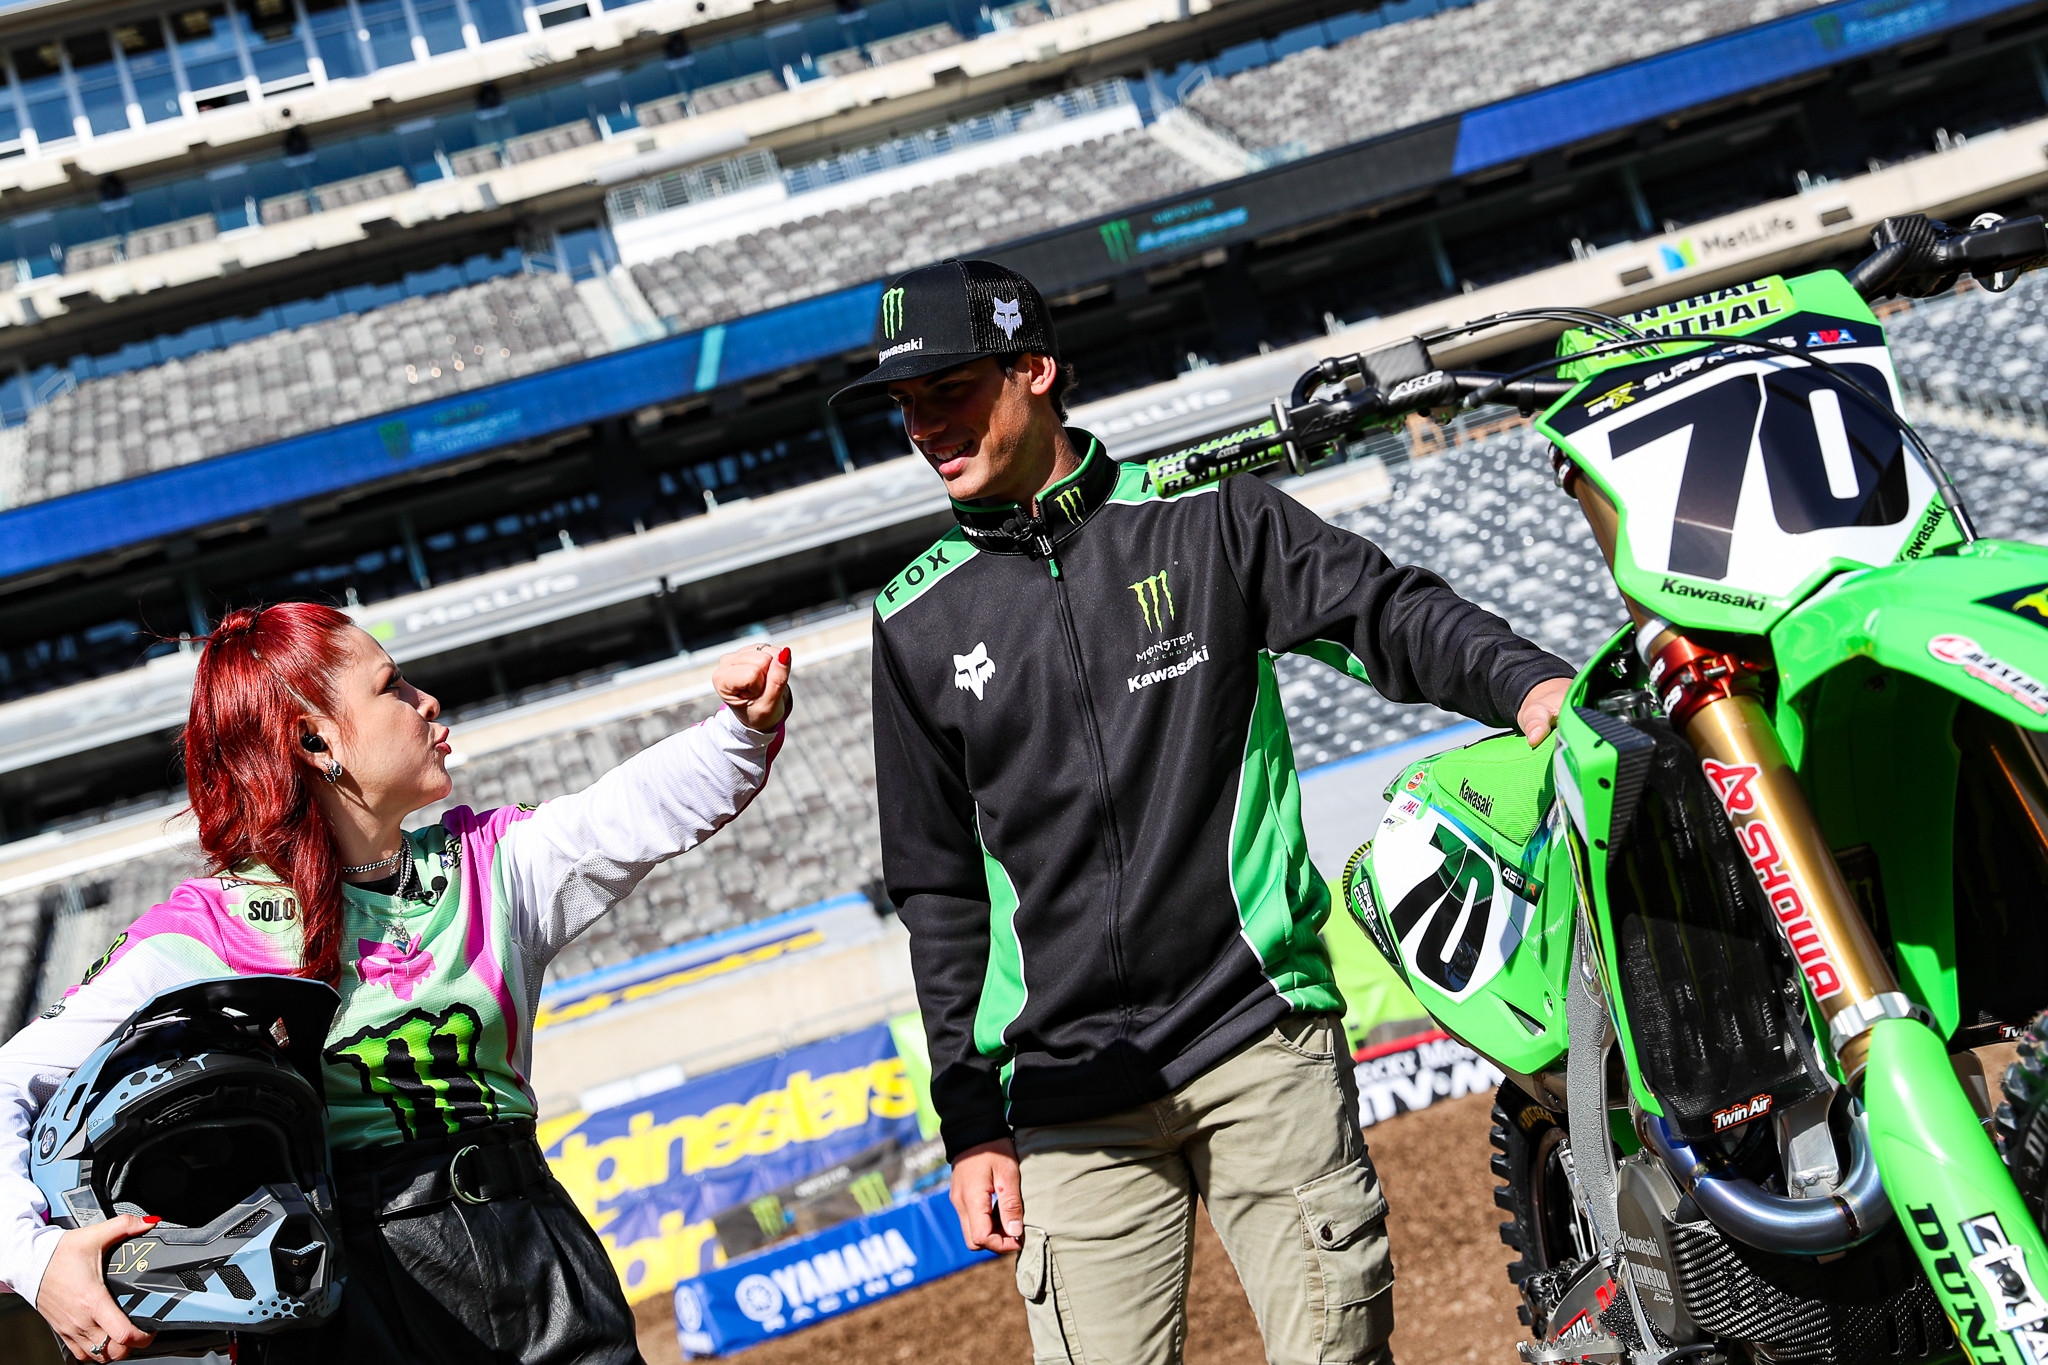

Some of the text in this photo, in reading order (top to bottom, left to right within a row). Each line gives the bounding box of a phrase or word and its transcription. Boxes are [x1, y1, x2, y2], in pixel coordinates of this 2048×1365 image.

[1702, 217, 1796, 255] MetLife
[1806, 329, 1858, 347] AMA
[1607, 362, 1911, 581] 70
[883, 546, 950, 604] FOX
[1659, 577, 1767, 612] Kawasaki
[405, 573, 580, 634] MetLife
[1127, 644, 1210, 693] Kawasaki
[1459, 777, 1495, 817] Kawasaki
[248, 897, 296, 922] SOLO
[1359, 881, 1378, 921] PRO
[1389, 823, 1494, 992] 70
[1734, 819, 1844, 1001] SHOWA
[1714, 1097, 1770, 1129] Twin Air
[1620, 1231, 1662, 1258] Kawasaki
[770, 1229, 917, 1308] YAMAHA
[762, 1267, 915, 1333] RACING
